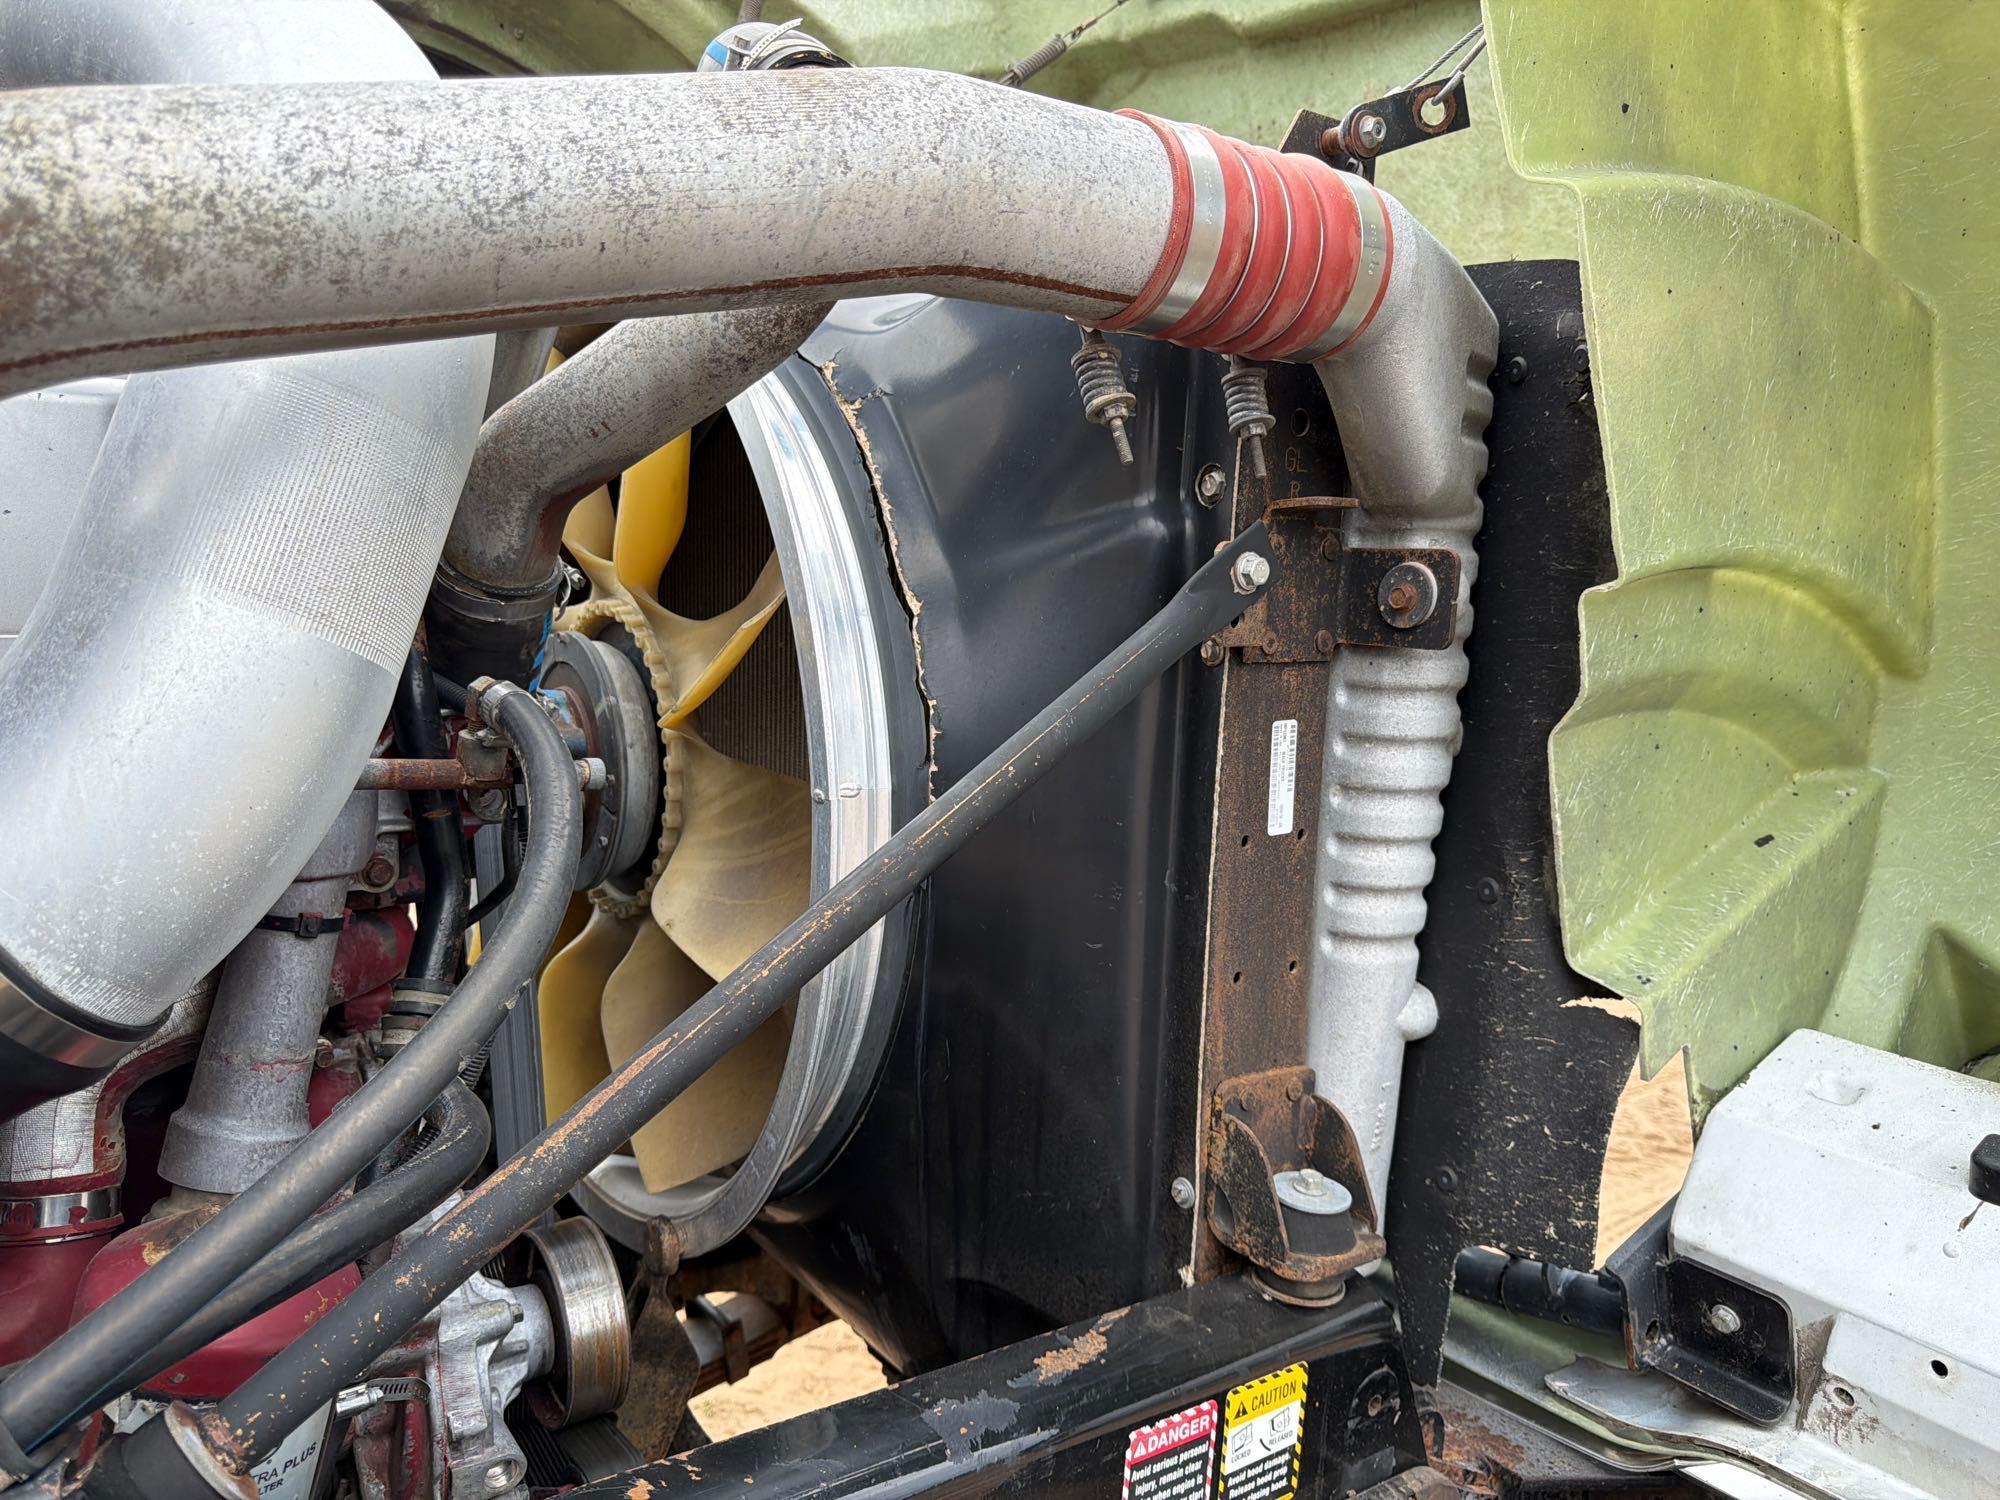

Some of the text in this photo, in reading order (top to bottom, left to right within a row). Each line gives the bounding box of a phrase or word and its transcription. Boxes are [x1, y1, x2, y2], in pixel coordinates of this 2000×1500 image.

[1251, 1380, 1297, 1411] CAUTION
[1147, 1414, 1210, 1453] DANGER
[1269, 1430, 1293, 1446] RELEASED
[282, 1442, 317, 1473] PLUS
[1131, 1440, 1209, 1482] Avoid serious personal
[1231, 1449, 1251, 1463] LOCKED
[1159, 1467, 1184, 1485] remain
[1185, 1460, 1203, 1475] clear
[1172, 1478, 1196, 1495] engine
[1196, 1473, 1204, 1485] is
[1227, 1470, 1247, 1487] Avoid
[1246, 1462, 1264, 1478] hood
[1229, 1465, 1288, 1500] Release hood prop
[1270, 1477, 1289, 1492] hood.
